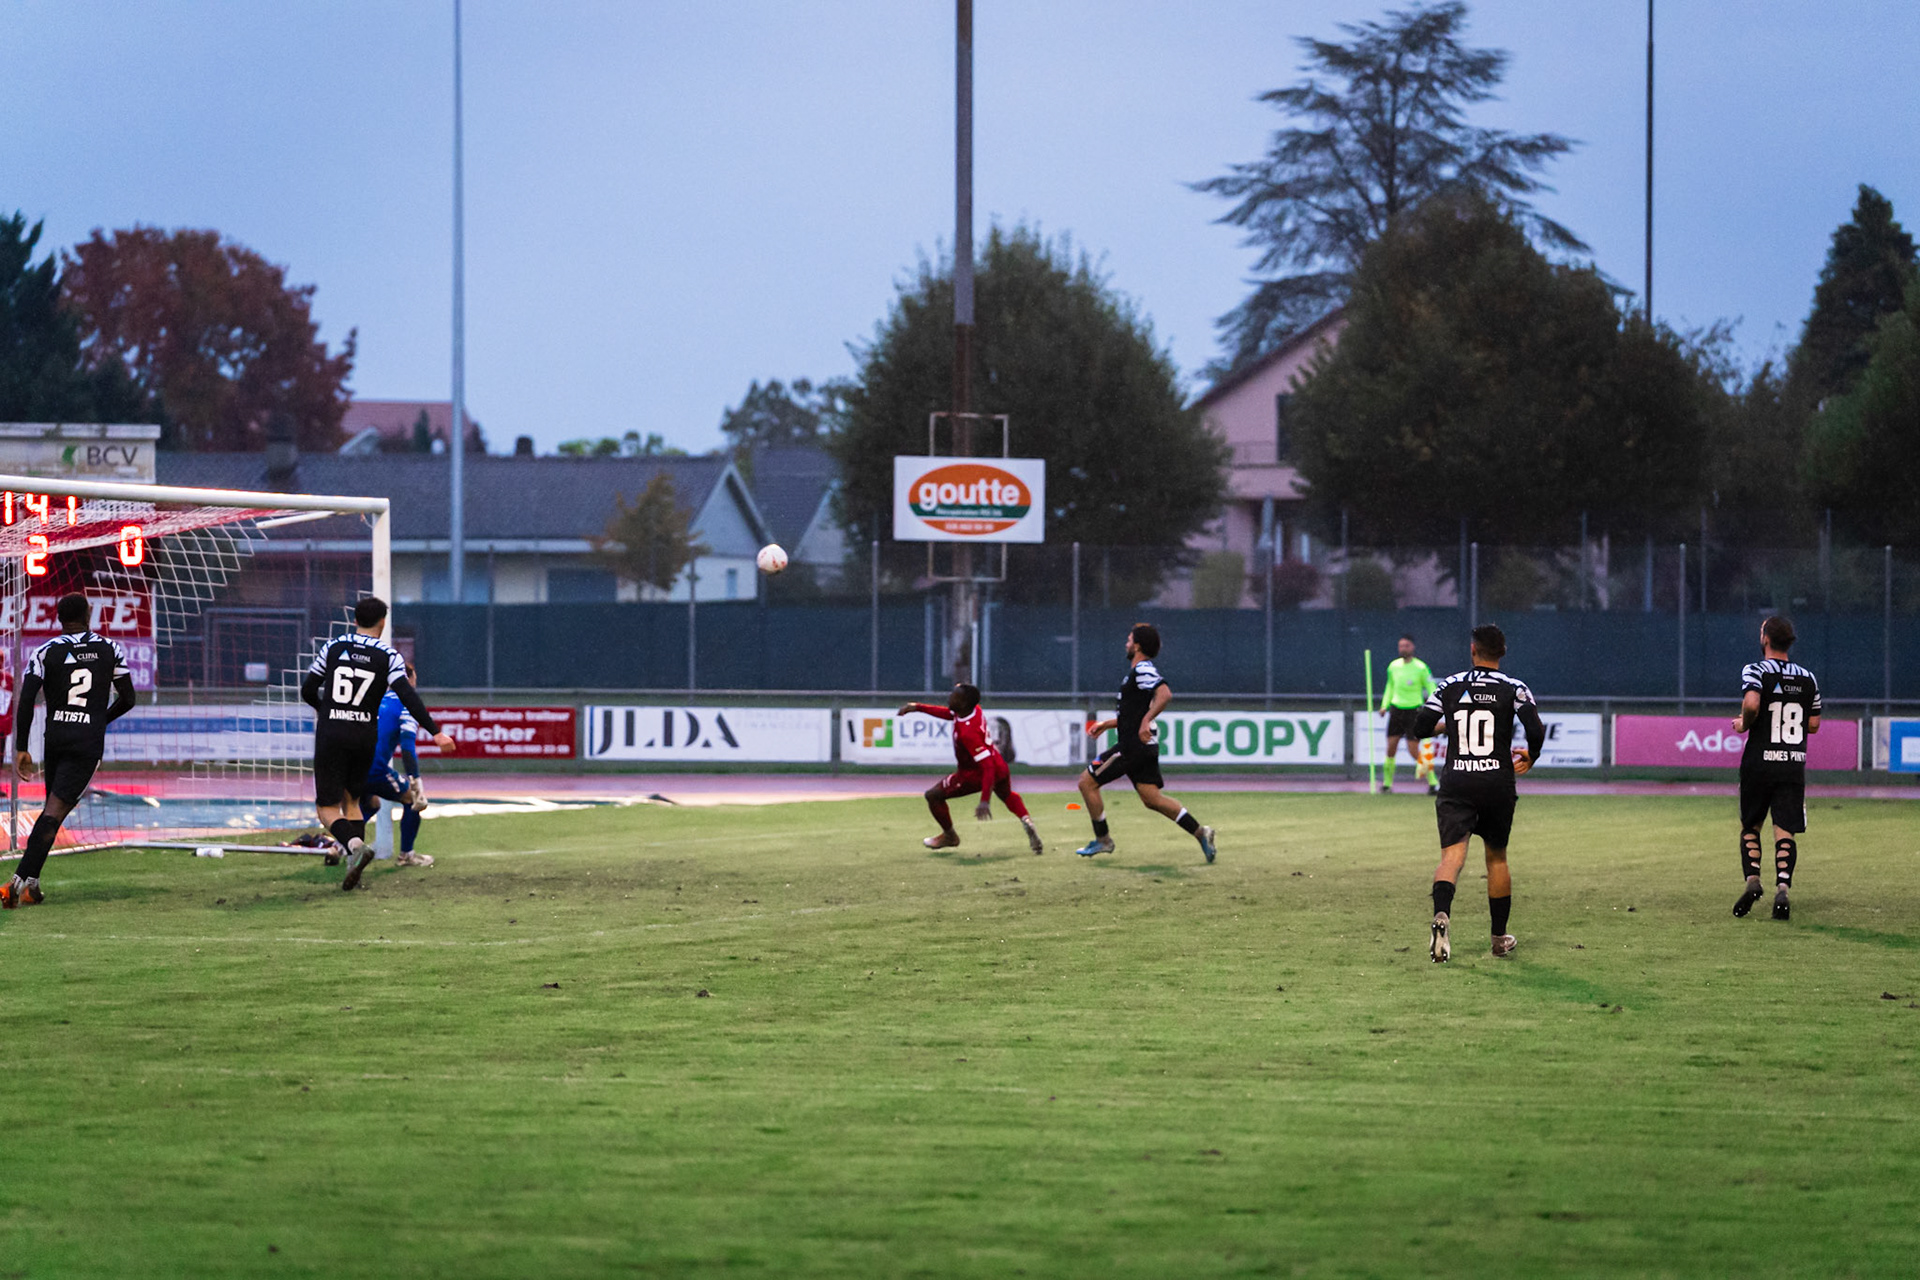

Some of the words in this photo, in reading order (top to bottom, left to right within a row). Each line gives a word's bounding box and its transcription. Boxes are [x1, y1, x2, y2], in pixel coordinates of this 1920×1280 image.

[87, 446, 139, 466] BCV
[918, 478, 1020, 511] goutte
[67, 668, 92, 707] 2
[332, 666, 376, 706] 67
[53, 709, 91, 724] BATISTA
[328, 708, 372, 722] AHMETAJ
[597, 709, 740, 754] JLDA
[1767, 701, 1804, 745] 18
[441, 723, 536, 742] Fischer
[1453, 709, 1495, 757] 10
[1763, 750, 1788, 762] GOMES
